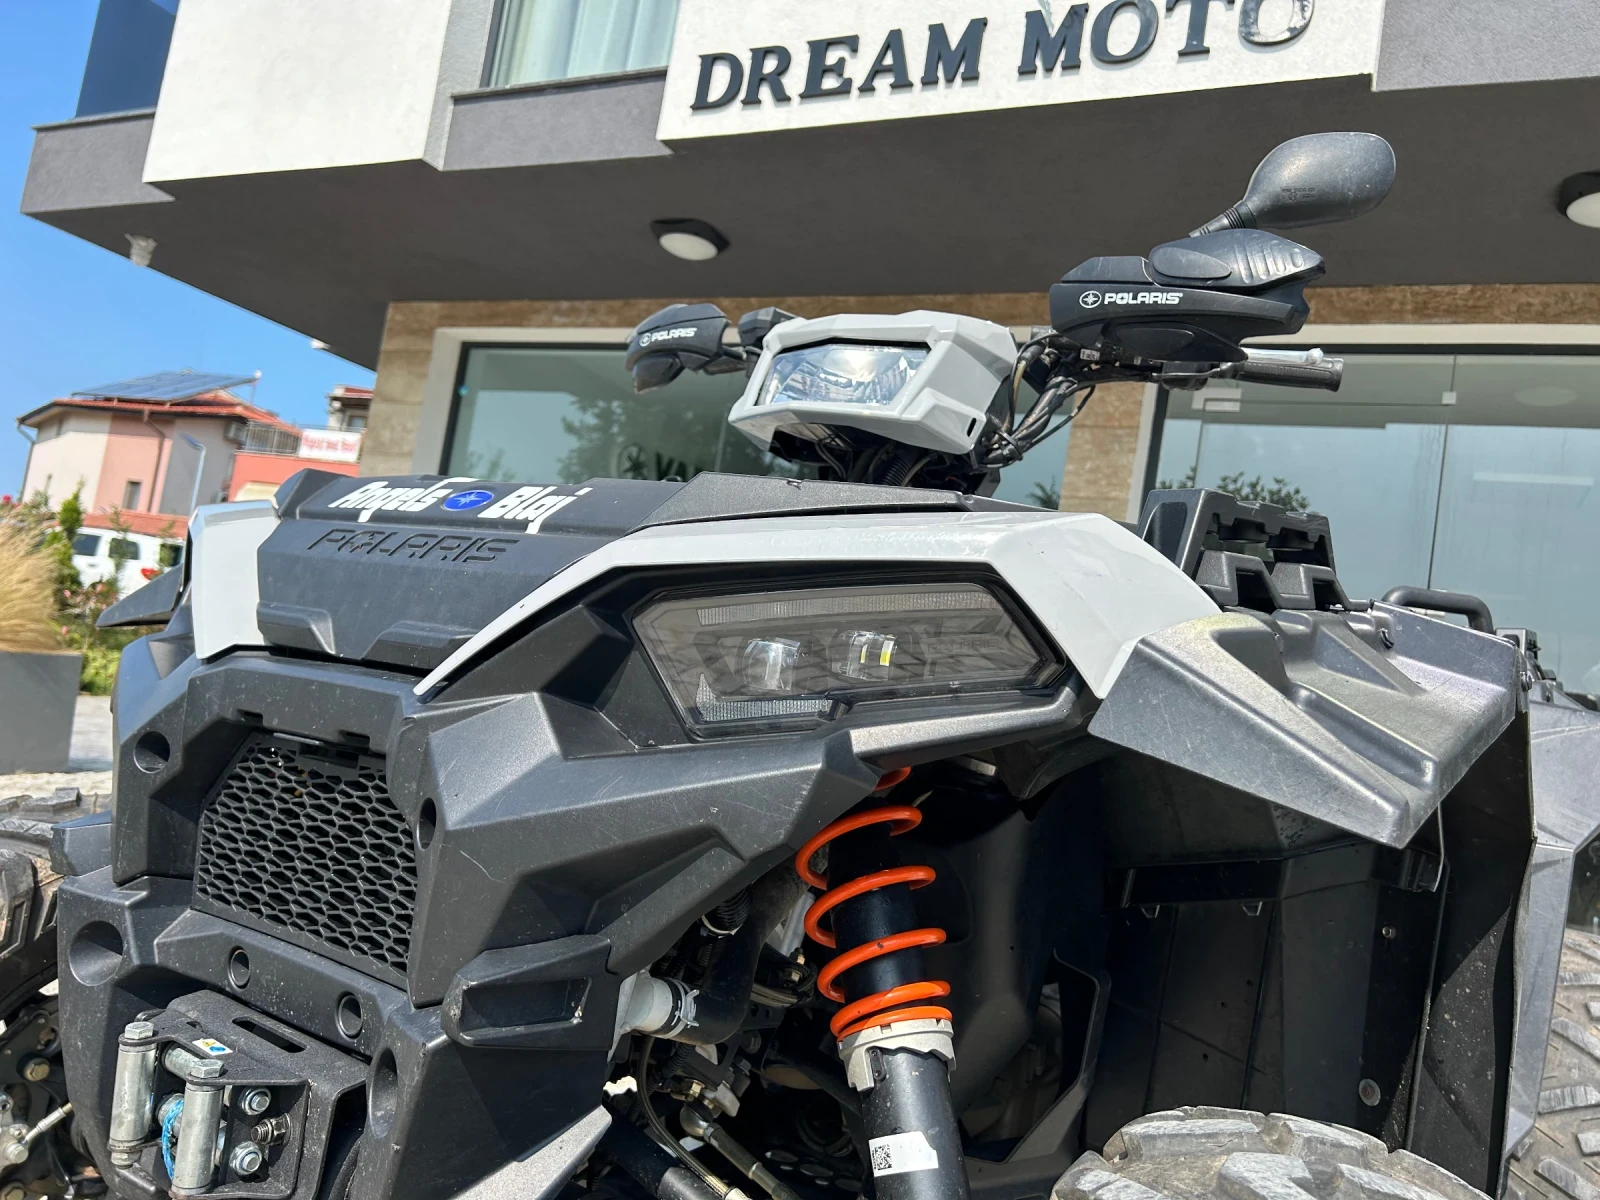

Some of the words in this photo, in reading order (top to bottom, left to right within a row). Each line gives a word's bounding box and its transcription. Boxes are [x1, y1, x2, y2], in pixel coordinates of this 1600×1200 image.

[690, 17, 988, 111] DREAM
[1018, 0, 1315, 75] MOTO
[1104, 292, 1182, 305] POLARIS
[651, 328, 697, 342] POLARIS
[307, 528, 520, 562] POLARIS
